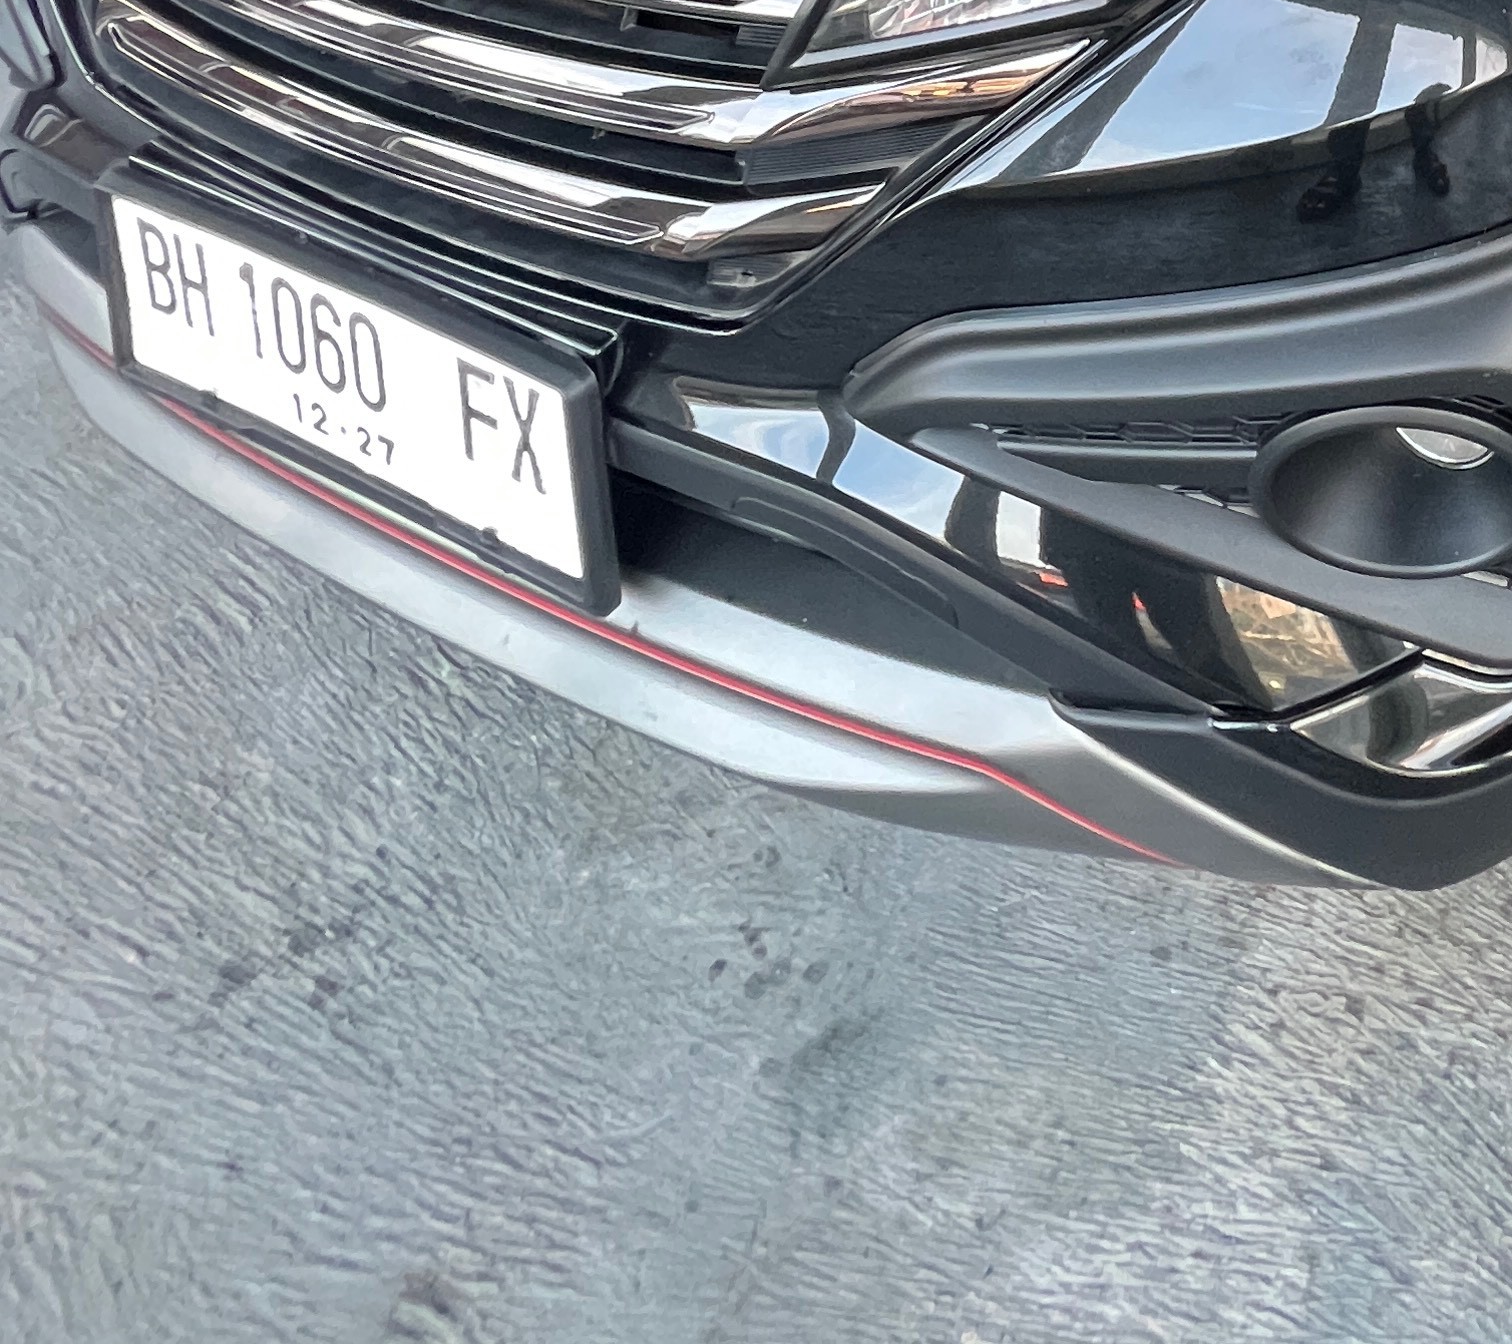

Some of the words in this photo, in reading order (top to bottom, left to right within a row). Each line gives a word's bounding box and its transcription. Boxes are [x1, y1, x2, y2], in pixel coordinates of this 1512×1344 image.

[136, 216, 216, 337] BH
[238, 262, 388, 413] 1060
[455, 355, 548, 496] FX
